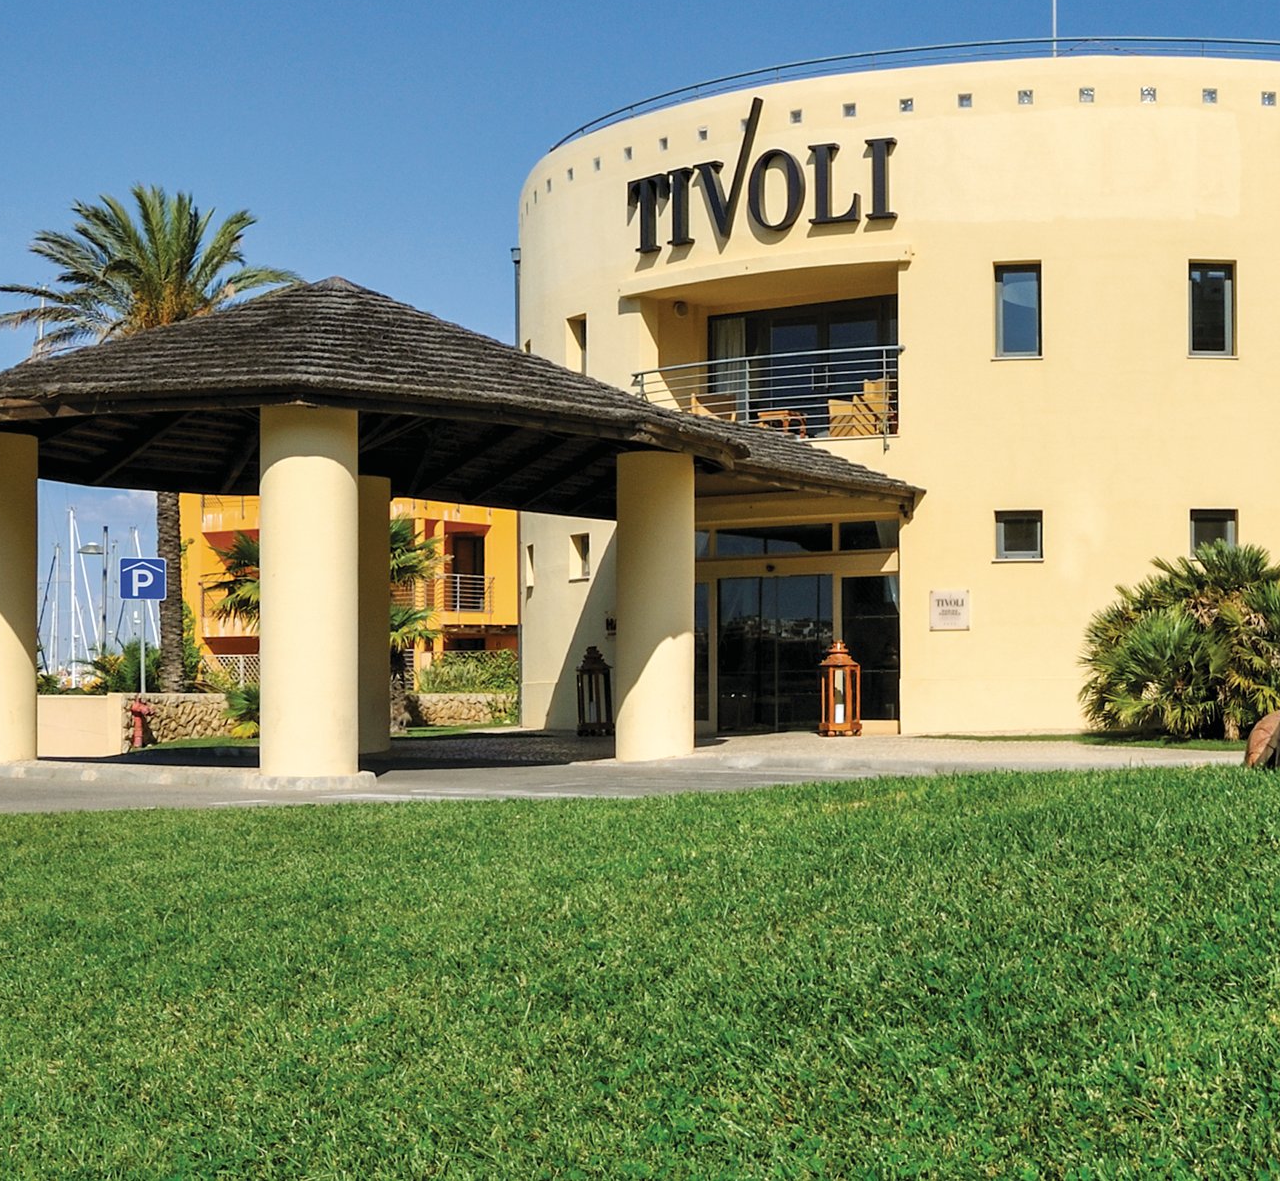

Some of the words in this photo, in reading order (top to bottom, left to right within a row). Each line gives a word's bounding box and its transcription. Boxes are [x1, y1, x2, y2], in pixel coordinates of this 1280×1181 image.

[627, 96, 898, 254] TIVOLI
[132, 568, 154, 597] P
[935, 595, 965, 607] TIVOLI
